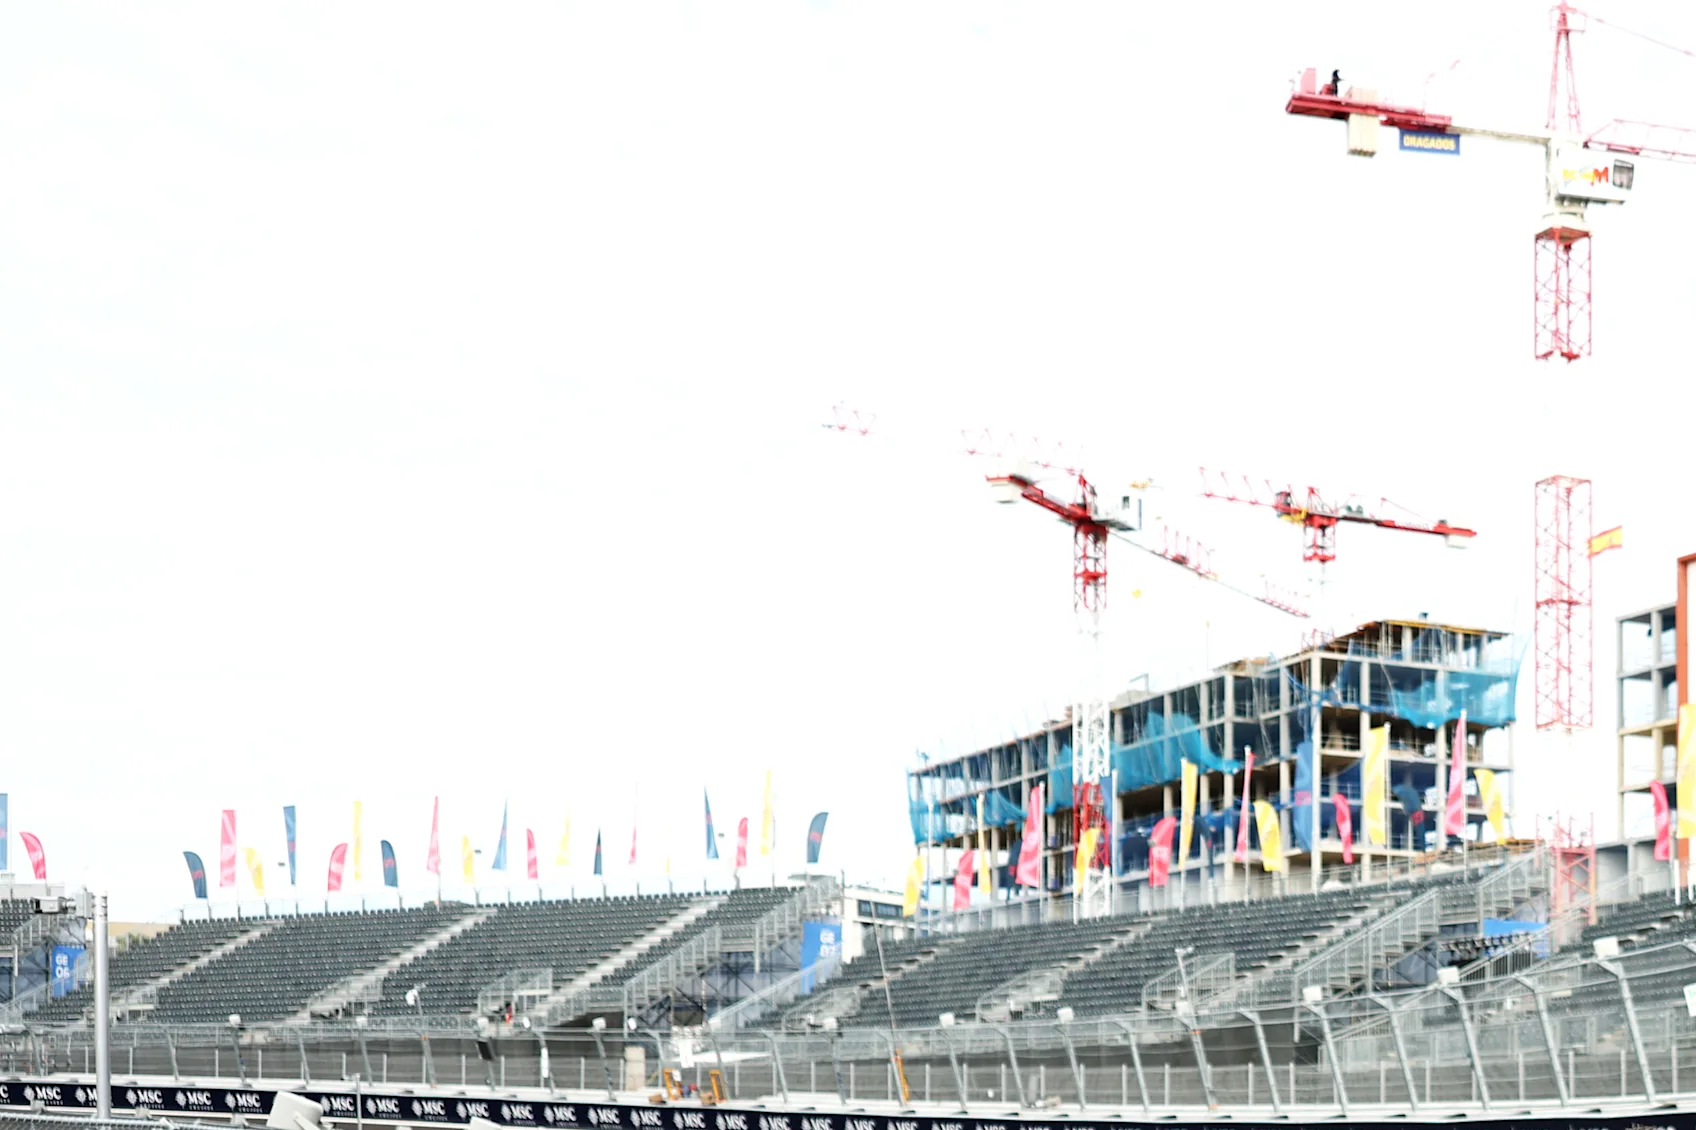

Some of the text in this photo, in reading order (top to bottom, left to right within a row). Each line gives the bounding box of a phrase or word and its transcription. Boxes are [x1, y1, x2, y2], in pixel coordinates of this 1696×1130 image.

[35, 1085, 62, 1100] MSC
[137, 1089, 163, 1104] MSC
[186, 1091, 212, 1106] MSC
[235, 1093, 261, 1107] MSC
[330, 1096, 355, 1111] MSC
[376, 1098, 400, 1112] MSC
[422, 1100, 446, 1115] MSC
[466, 1102, 490, 1117] MSC
[510, 1104, 534, 1119] MSC
[553, 1106, 577, 1122] MSC
[596, 1108, 621, 1124] MSC
[639, 1110, 662, 1126] MSC
[682, 1112, 706, 1128] MSC
[725, 1114, 748, 1130] MSC
